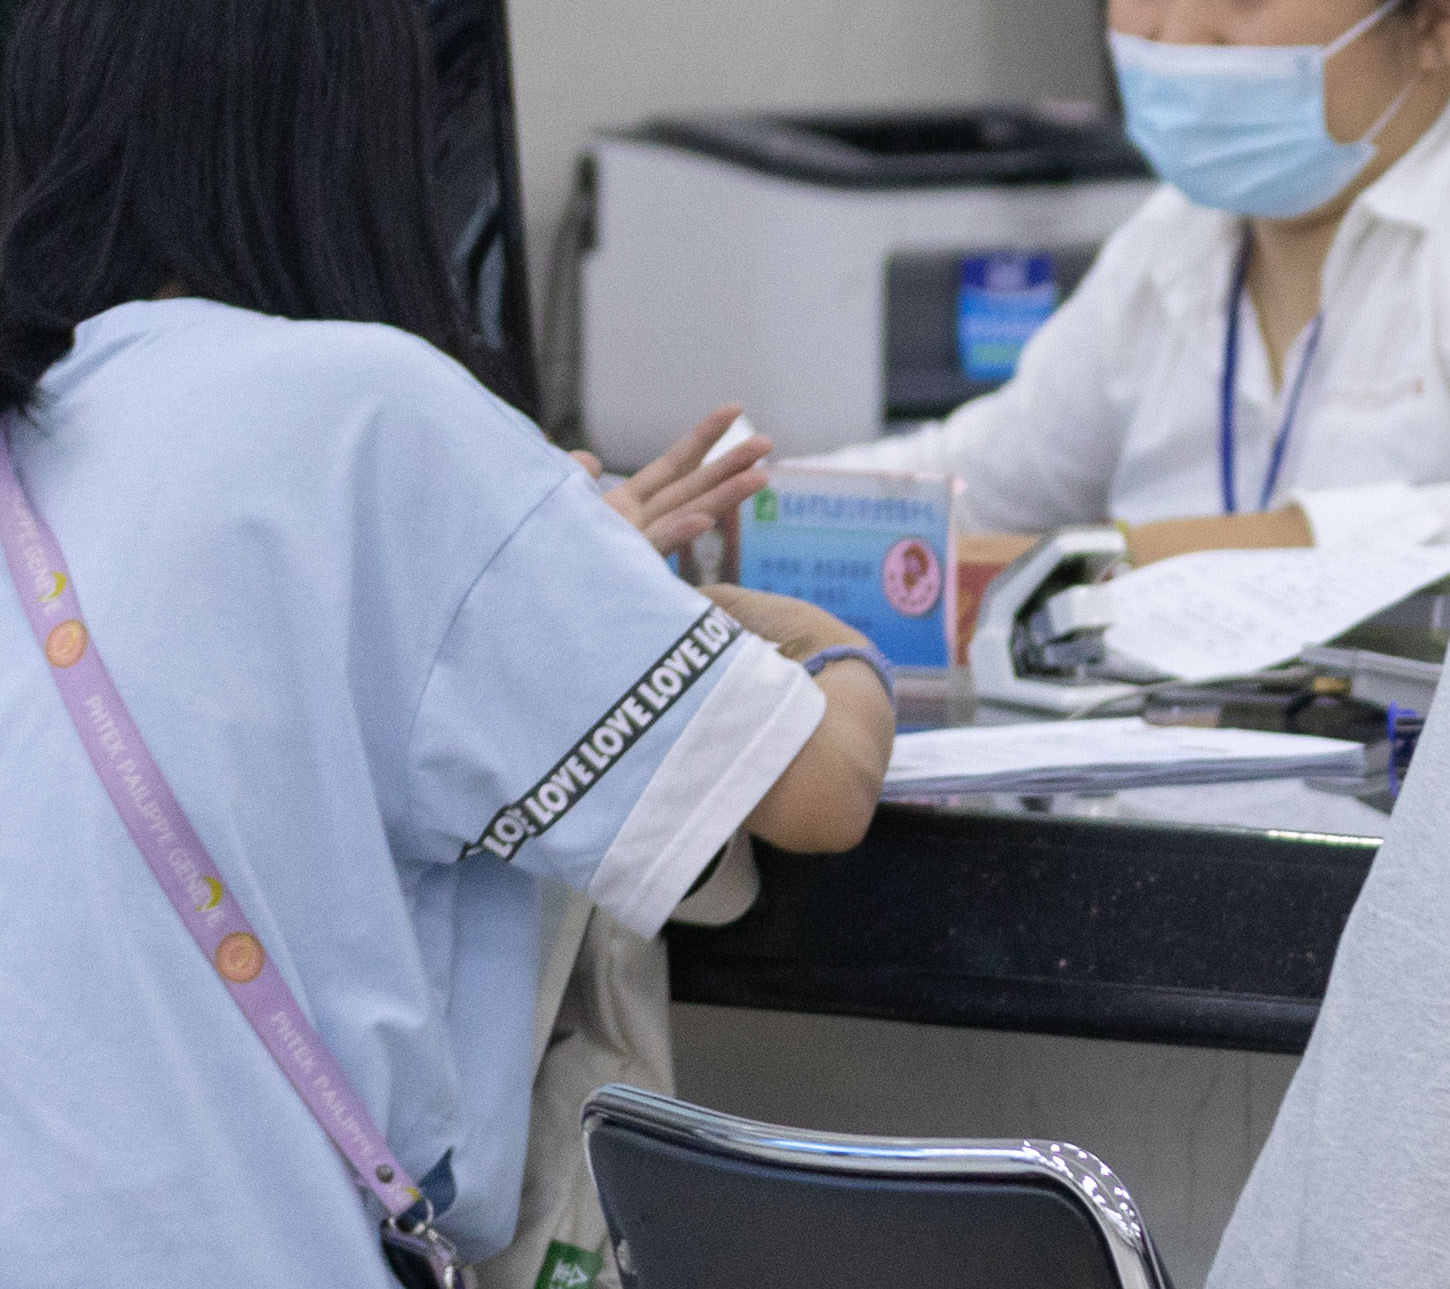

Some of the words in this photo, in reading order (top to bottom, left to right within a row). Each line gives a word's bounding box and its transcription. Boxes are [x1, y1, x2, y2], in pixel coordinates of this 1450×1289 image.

[524, 755, 595, 826] LOVE
[579, 696, 654, 771] LOVE
[636, 636, 710, 712] LOVE
